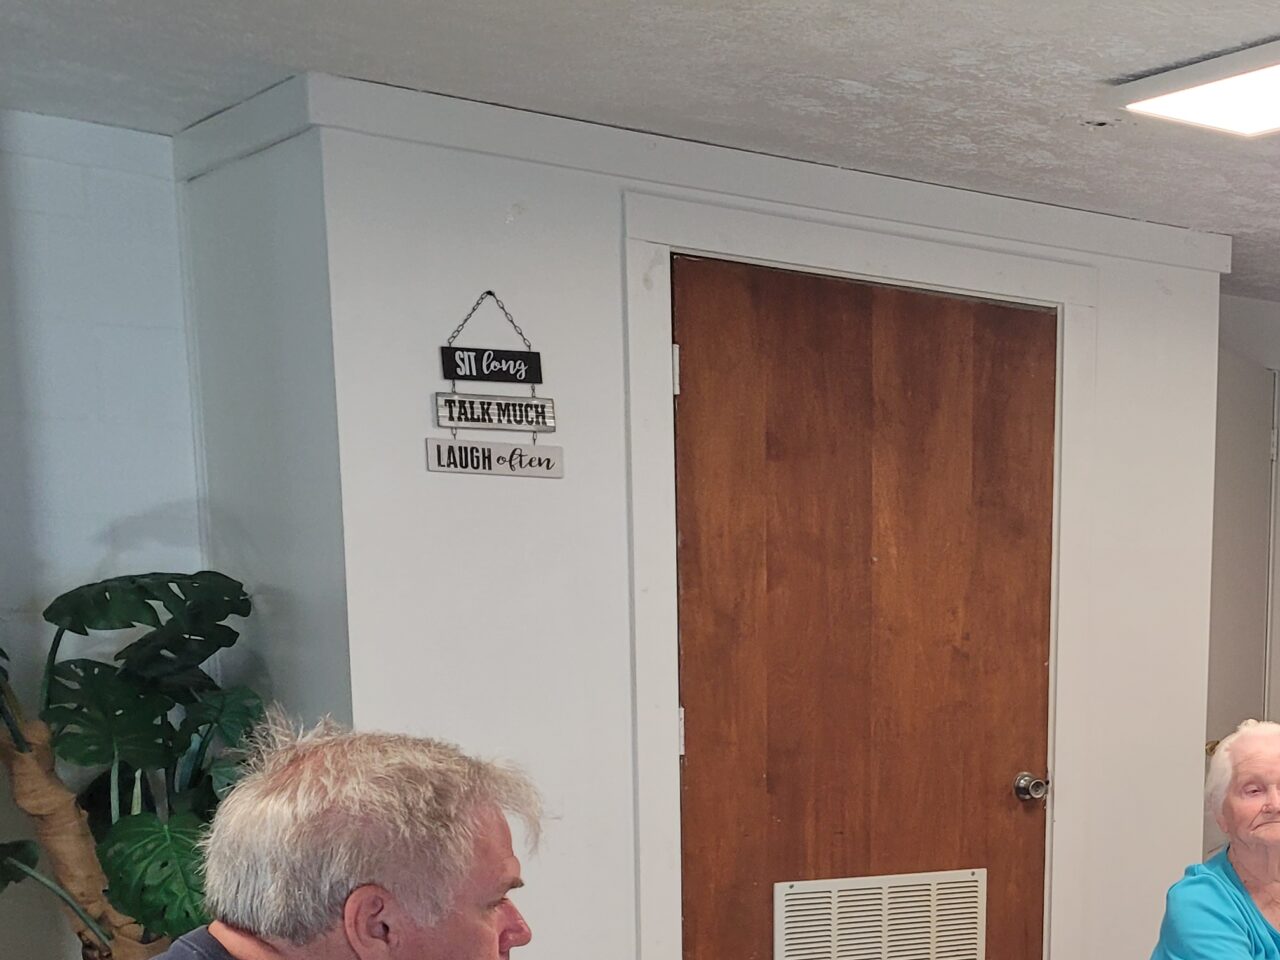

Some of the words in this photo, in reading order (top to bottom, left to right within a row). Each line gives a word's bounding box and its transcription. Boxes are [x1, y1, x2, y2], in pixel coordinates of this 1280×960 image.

[455, 351, 477, 376] SIT
[482, 350, 528, 380] long
[444, 399, 494, 424] TALK
[496, 402, 548, 426] MUCH
[436, 444, 492, 471] LAUGH
[496, 447, 555, 472] often
